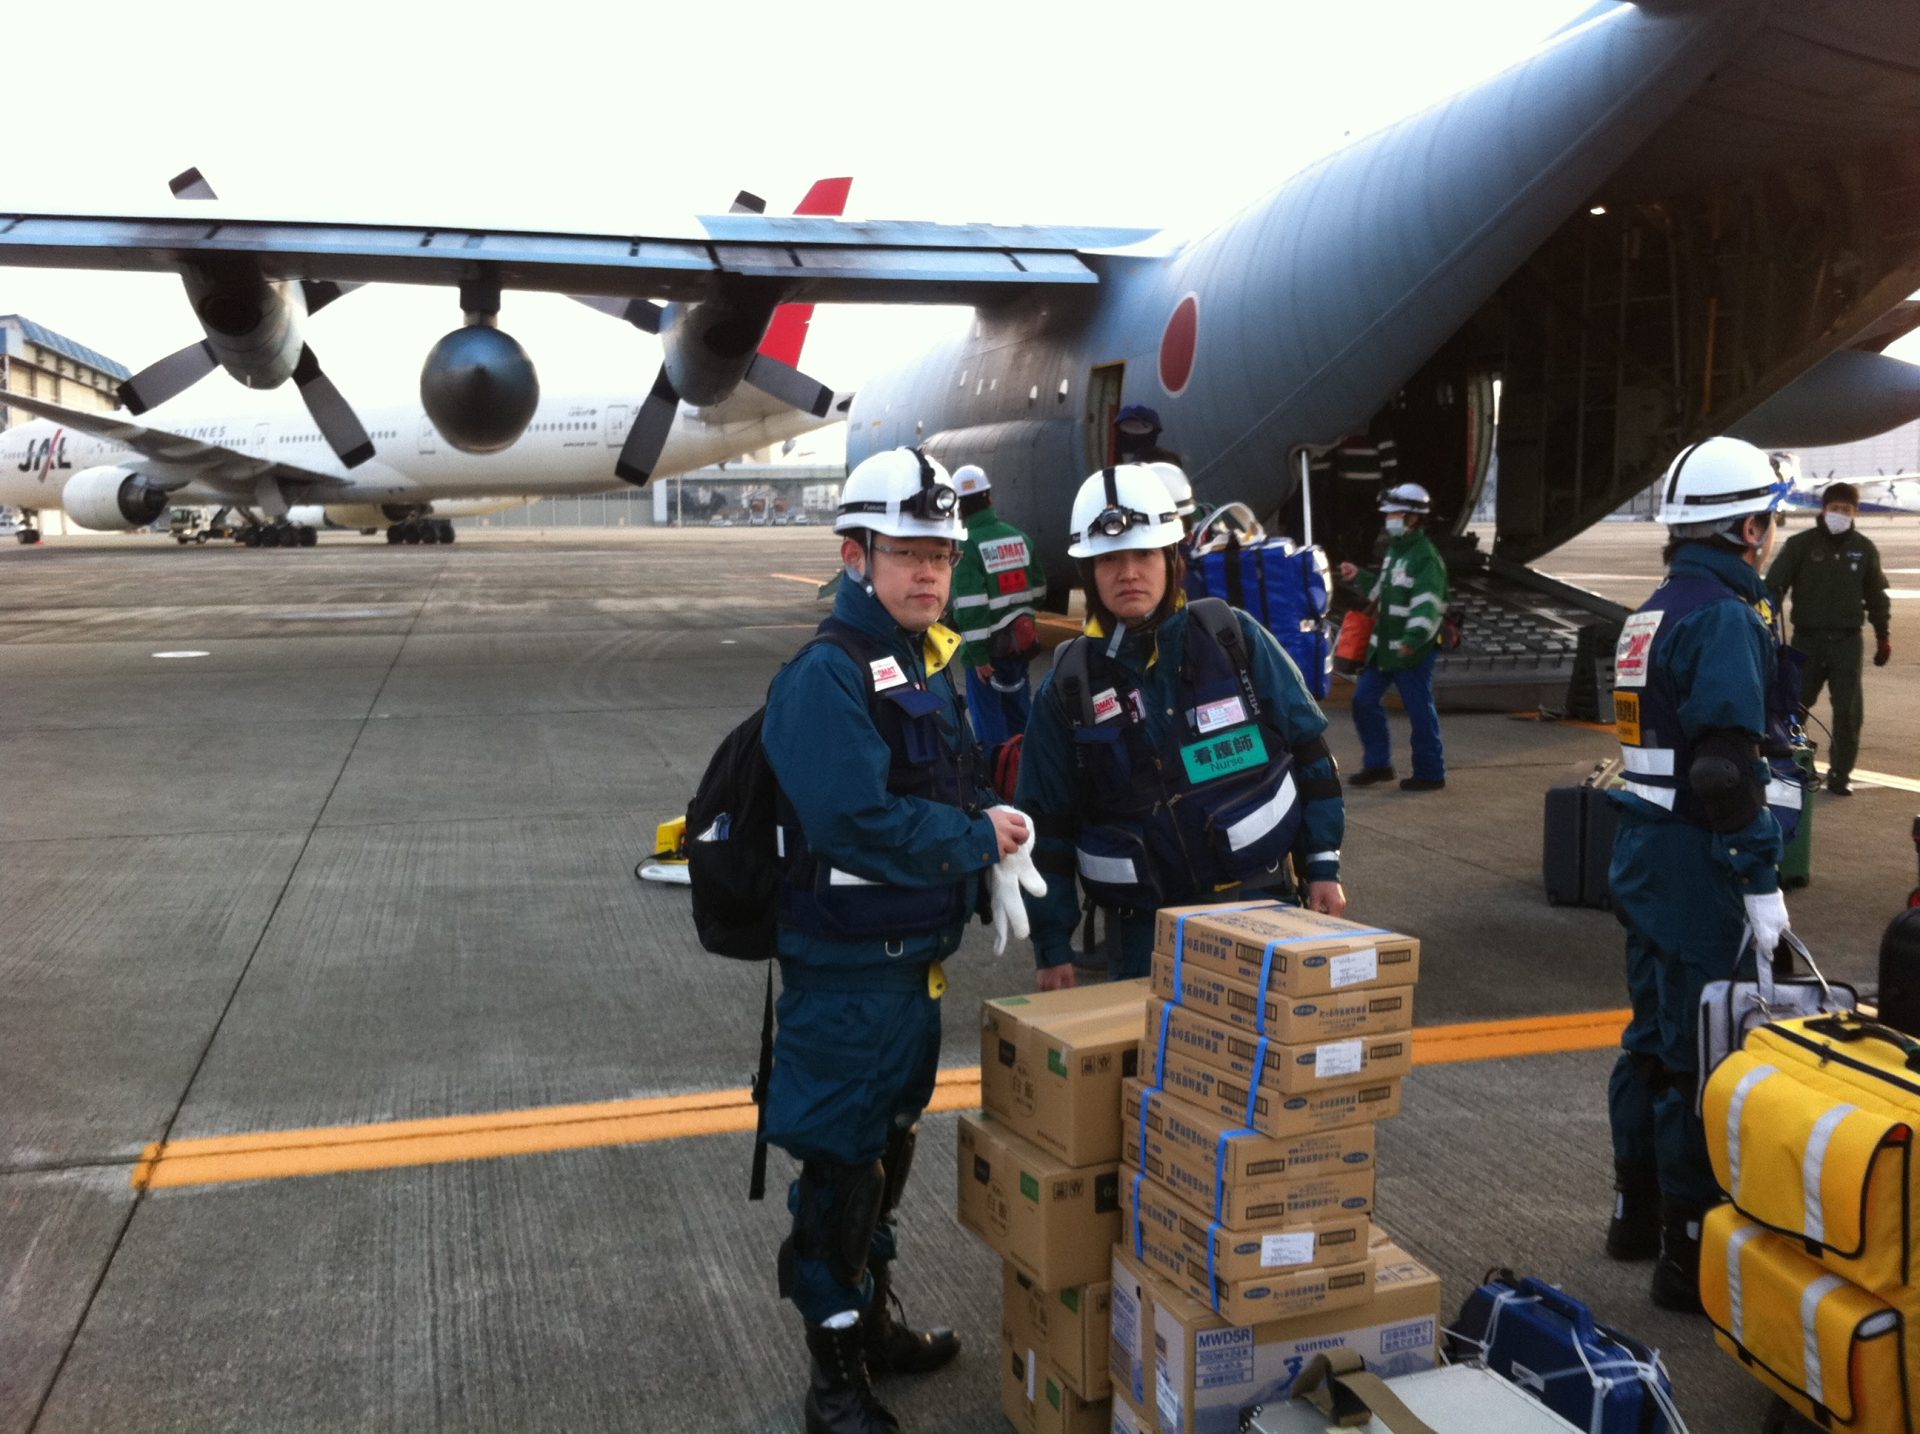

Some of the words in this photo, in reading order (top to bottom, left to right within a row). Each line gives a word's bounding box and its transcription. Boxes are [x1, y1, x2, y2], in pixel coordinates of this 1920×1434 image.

[18, 436, 72, 472] JAL
[1194, 733, 1253, 766] 看護師
[1211, 756, 1244, 772] Nurse
[1198, 1329, 1250, 1348] MWD5R
[1294, 1336, 1345, 1352] SUNTORY
